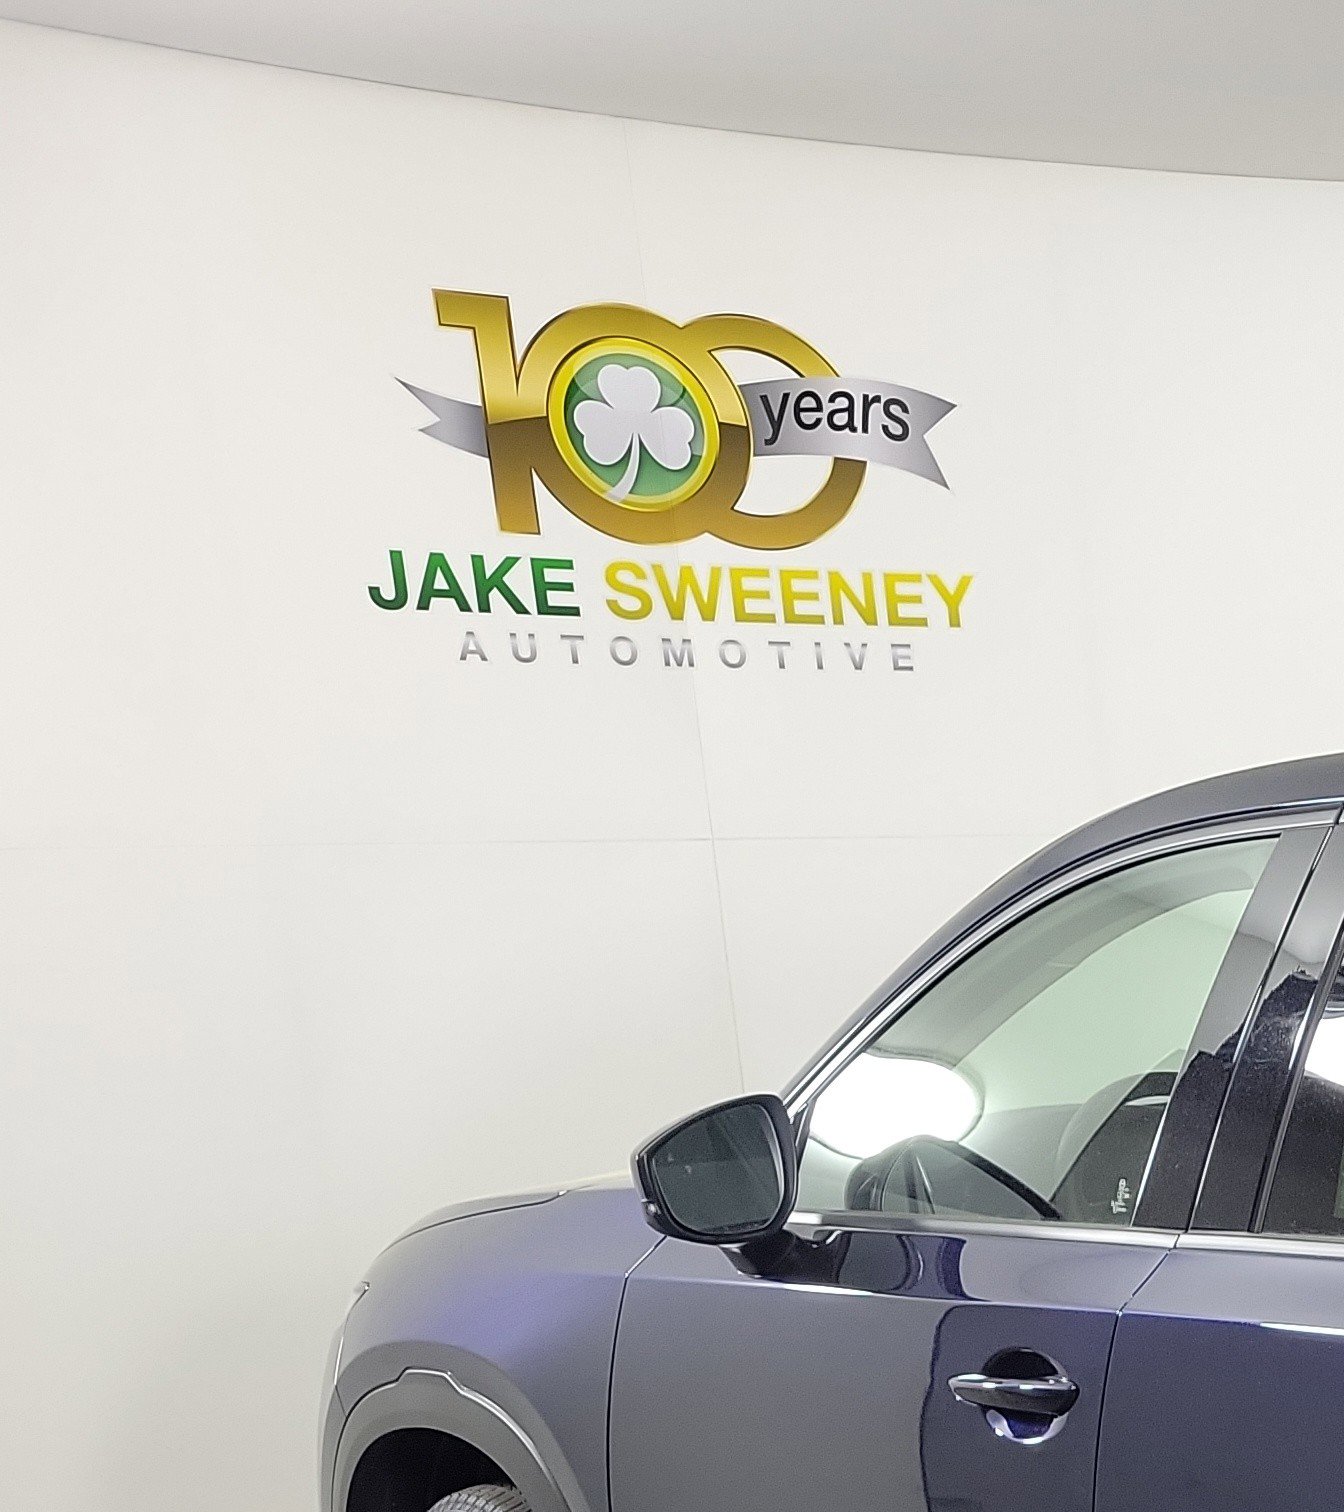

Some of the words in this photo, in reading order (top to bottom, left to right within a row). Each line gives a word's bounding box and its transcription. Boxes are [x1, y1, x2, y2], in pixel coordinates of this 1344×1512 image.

[759, 389, 912, 447] years
[367, 550, 582, 617] JAKE
[605, 561, 974, 628] SWEENEY
[459, 631, 915, 672] AUTOMOTIVE
